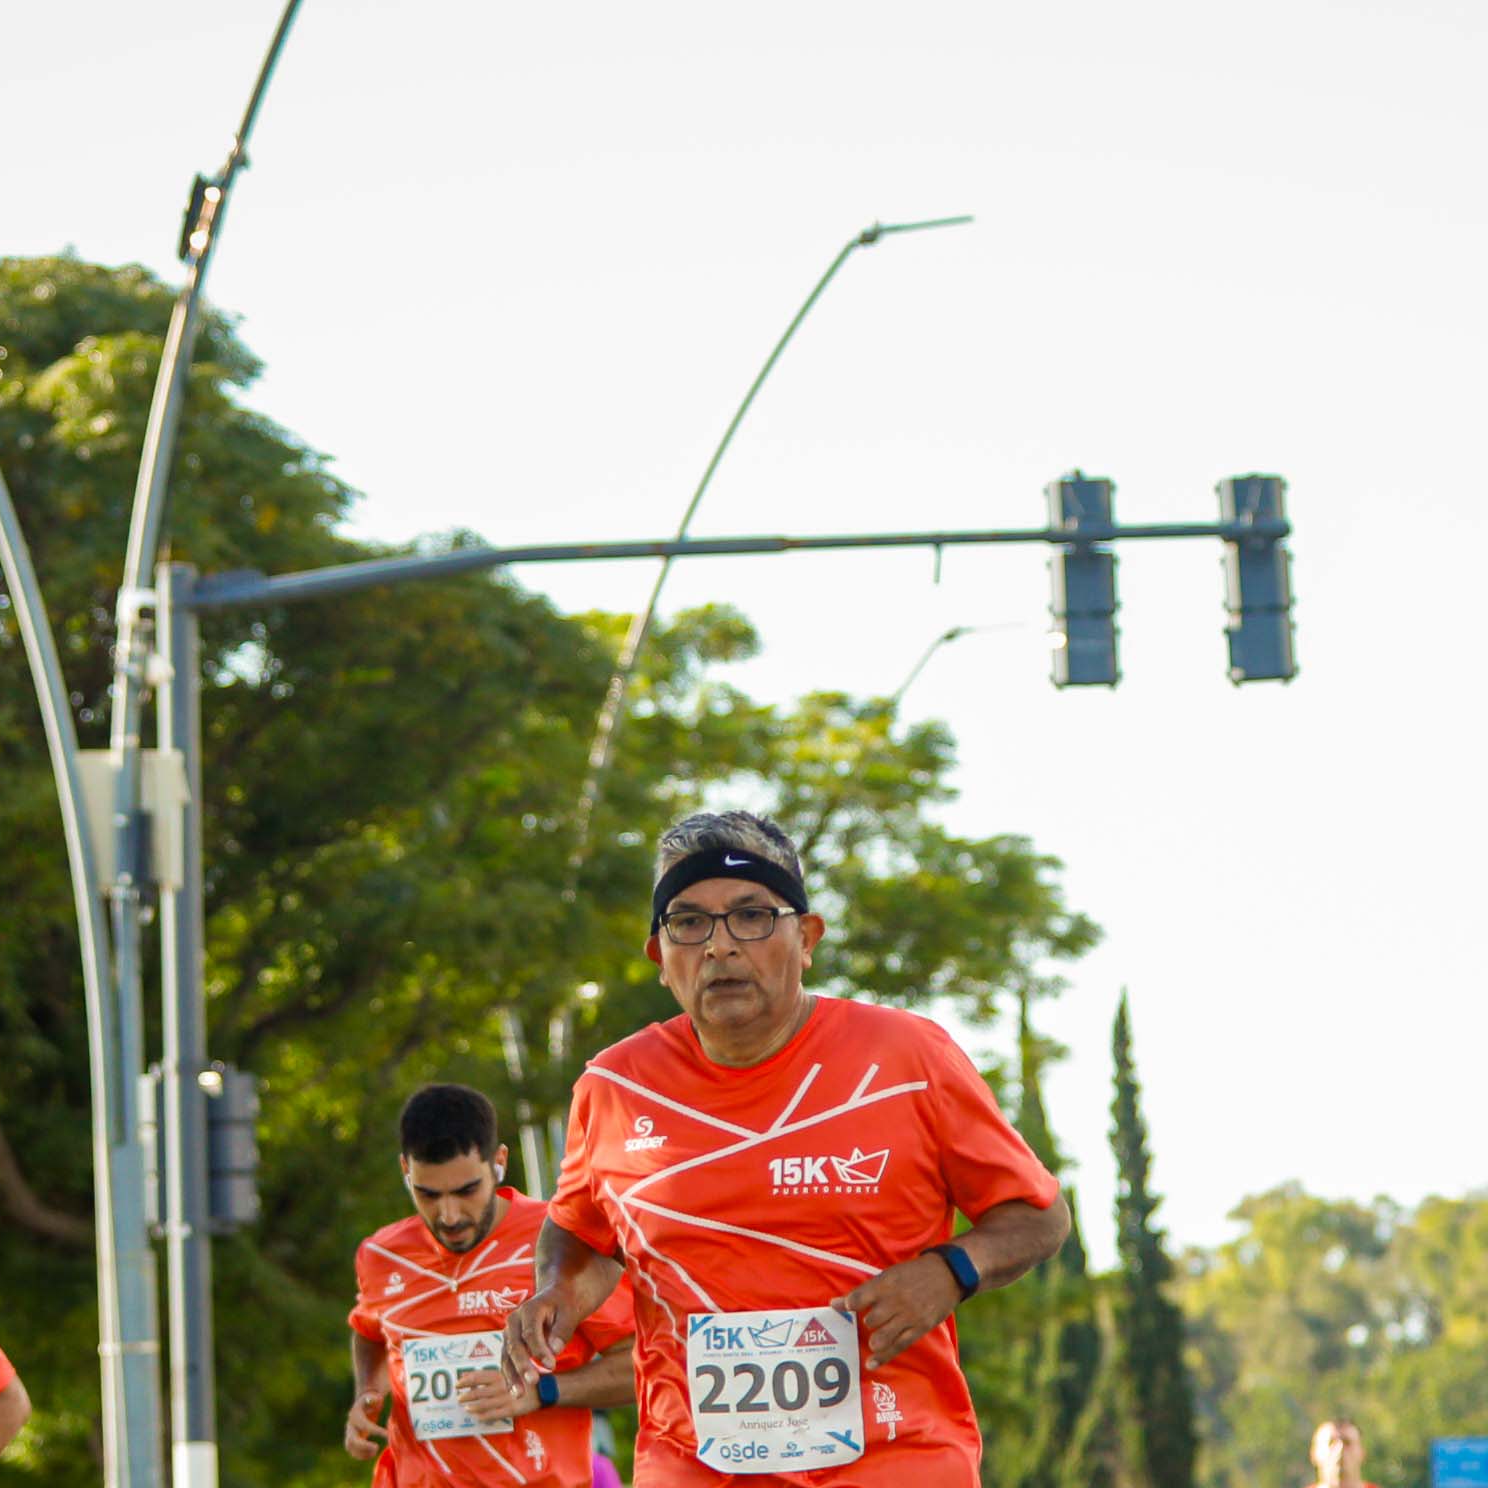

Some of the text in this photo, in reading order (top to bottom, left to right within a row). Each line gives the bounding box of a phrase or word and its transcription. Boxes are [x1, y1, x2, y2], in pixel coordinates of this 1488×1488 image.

[768, 1156, 829, 1185] 15K
[772, 1186, 879, 1195] PUERTO NORTE
[458, 1290, 490, 1310] 15K
[703, 1327, 744, 1350] 15K
[803, 1329, 828, 1343] 15K
[695, 1357, 851, 1413] 2209
